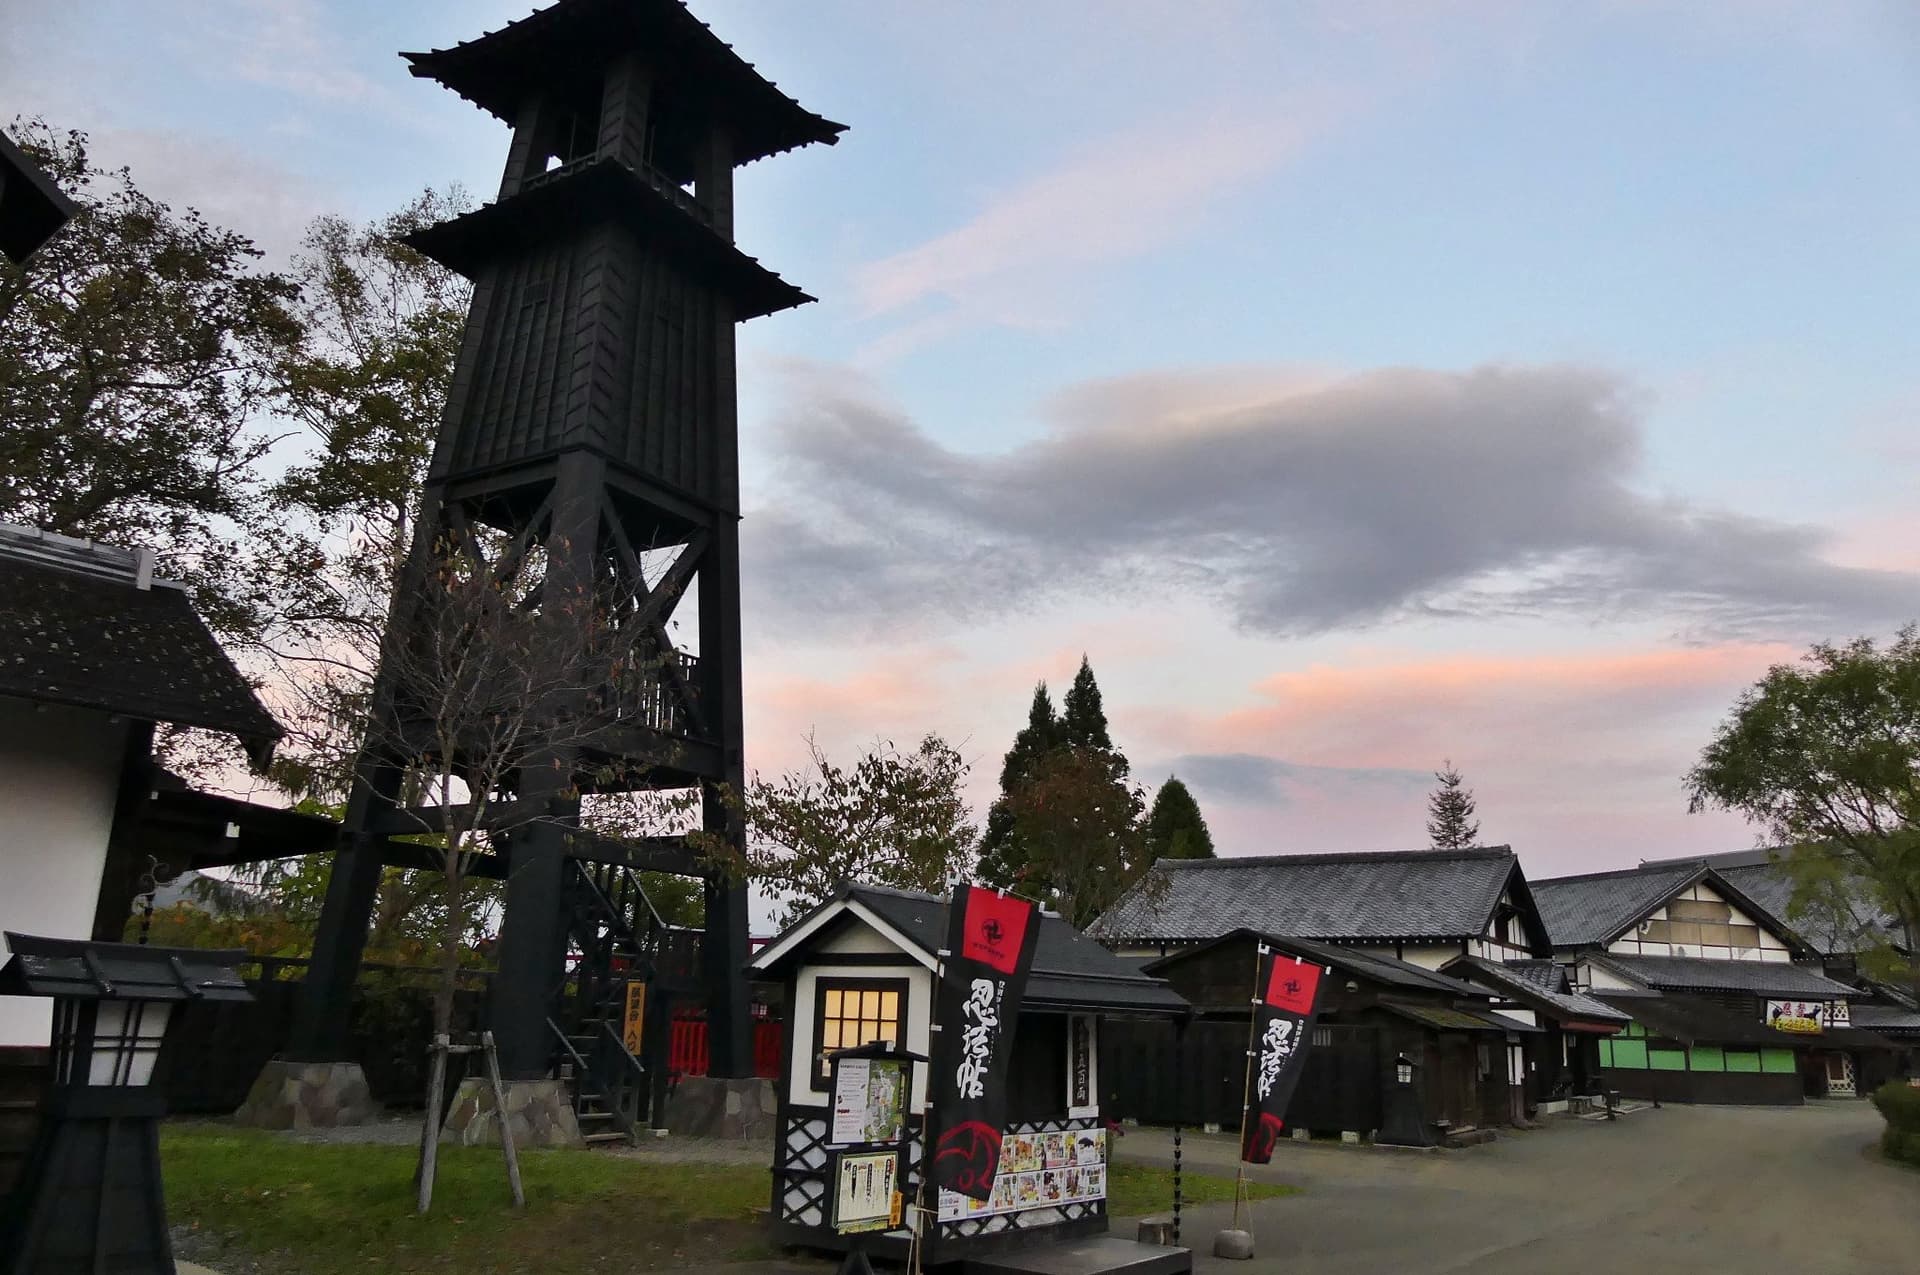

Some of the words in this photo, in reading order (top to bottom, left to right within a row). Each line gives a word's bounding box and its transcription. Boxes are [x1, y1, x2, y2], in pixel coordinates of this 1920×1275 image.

[957, 979, 999, 1099] 忍法帖
[1257, 1018, 1293, 1102] 忍法帖
